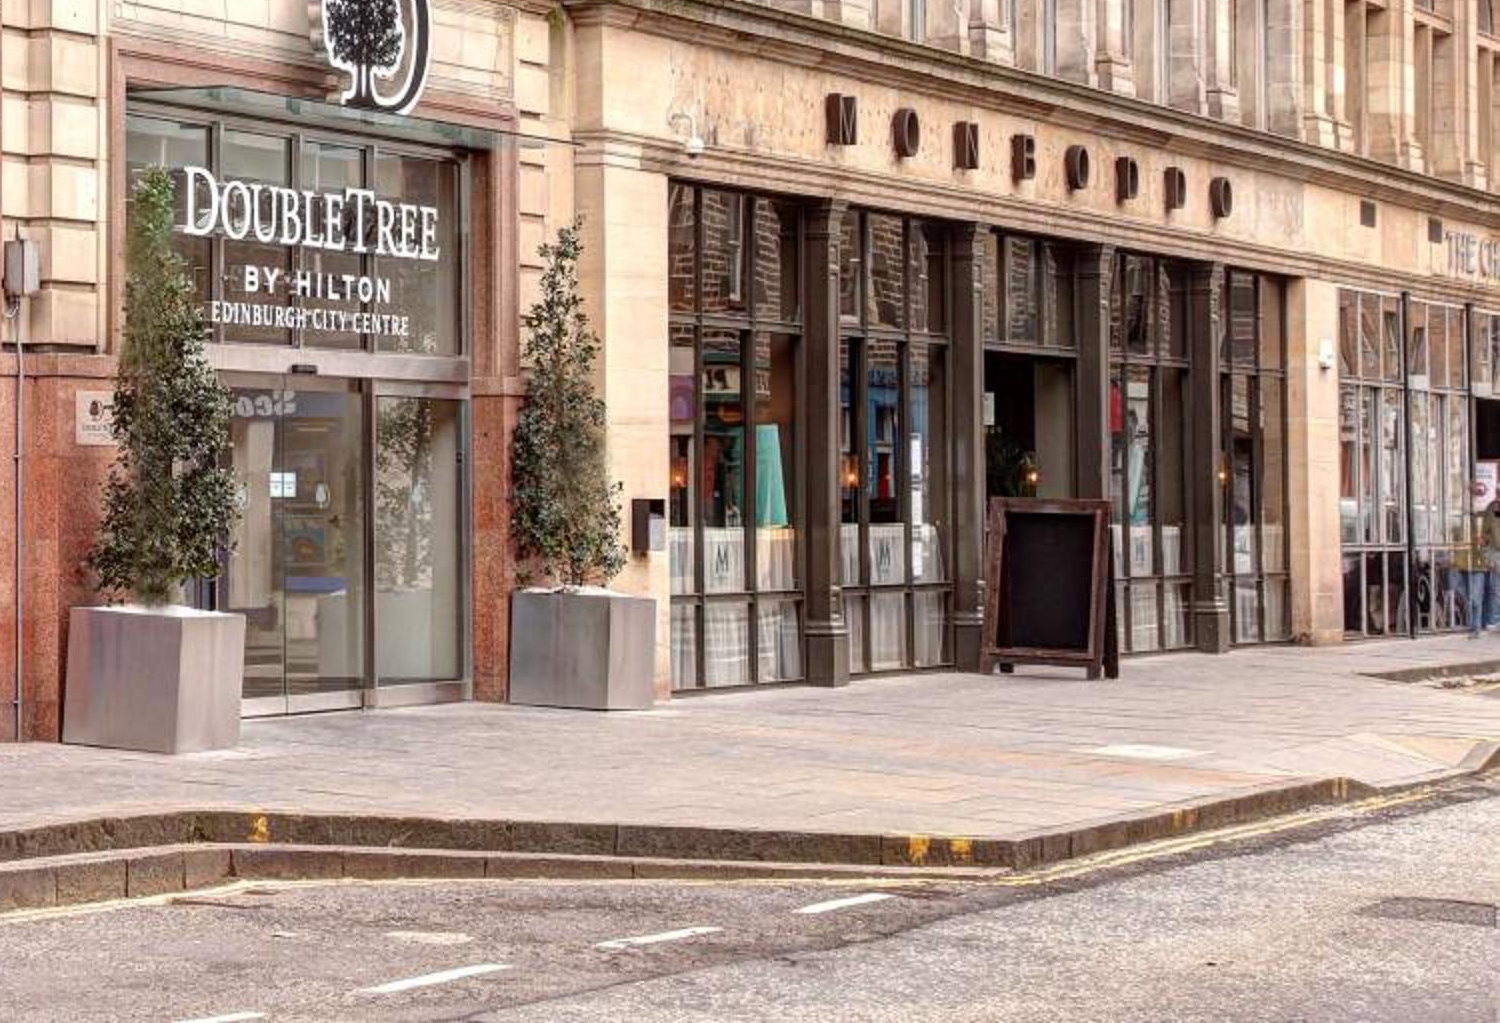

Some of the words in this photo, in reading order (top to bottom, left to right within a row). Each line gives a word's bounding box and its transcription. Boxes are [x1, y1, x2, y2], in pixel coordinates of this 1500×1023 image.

[826, 92, 1233, 218] MONBODDO
[244, 264, 280, 294] BY
[297, 270, 391, 304] HILTON
[211, 300, 308, 329] EDINBURGH
[312, 308, 347, 331] CITY
[352, 312, 410, 337] CENTRE
